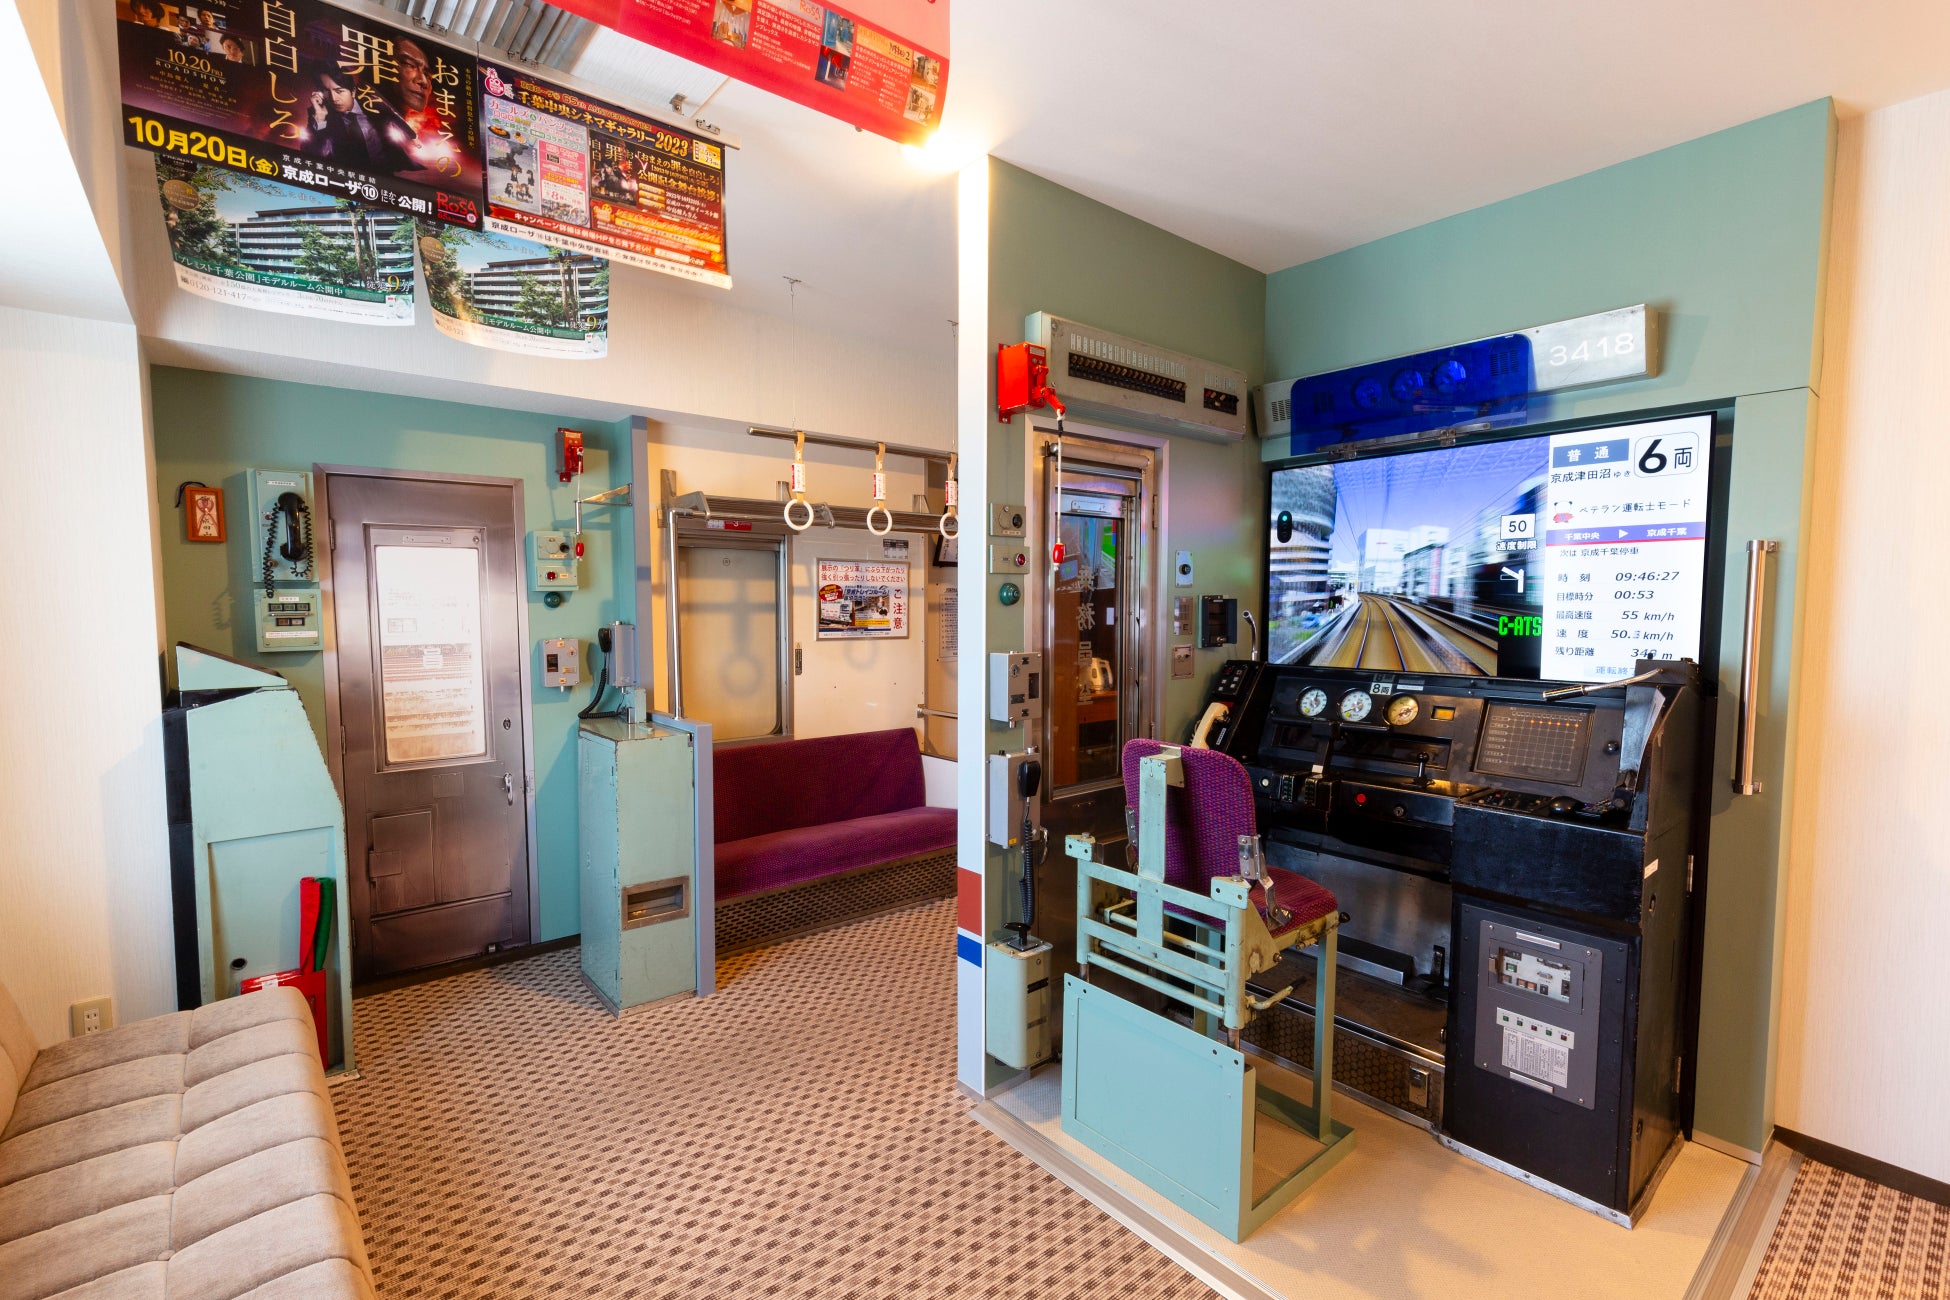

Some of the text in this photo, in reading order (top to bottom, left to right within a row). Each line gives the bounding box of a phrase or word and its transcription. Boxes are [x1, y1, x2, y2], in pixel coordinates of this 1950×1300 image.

[168, 49, 211, 73] 10.20
[262, 0, 300, 140] 自白しろ
[337, 23, 400, 115] 罪を
[155, 60, 226, 85] ROADSHOW
[431, 56, 462, 178] おまえの
[128, 115, 280, 177] 10月20日(金)
[282, 154, 376, 184] 京成千葉中央駅直結
[1549, 332, 1635, 367] 3418
[1567, 445, 1610, 463] 普通
[1579, 499, 1691, 514] ベテラン運転士モード
[1508, 520, 1527, 533] 50
[1565, 527, 1688, 541] 千葉中央 京成千葉
[1496, 540, 1538, 551] 速度制限
[1581, 546, 1639, 558] 京成千葉停車
[1615, 571, 1680, 582] 09:46:27
[1556, 590, 1655, 602] 目標時分 00:53
[893, 588, 904, 630] ご注意
[1556, 610, 1675, 622] 最高速度 55 km/h
[1498, 615, 1543, 637] C-ATS
[1643, 631, 1674, 642] km/h
[1555, 646, 1595, 657] 残り距離
[1661, 652, 1673, 660] m
